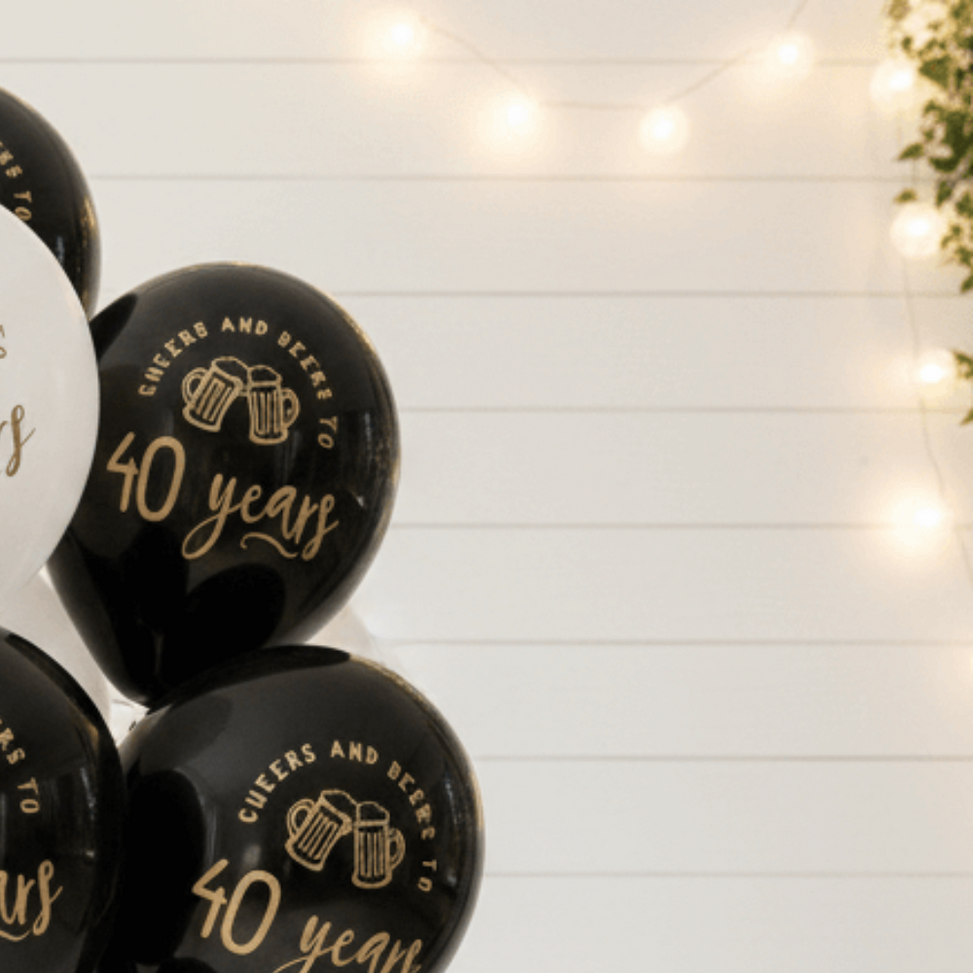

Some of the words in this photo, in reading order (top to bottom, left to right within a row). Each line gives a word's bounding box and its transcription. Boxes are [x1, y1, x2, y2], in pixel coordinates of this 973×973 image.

[13, 190, 33, 222] TO
[138, 321, 209, 397] CHEERS
[221, 316, 268, 336] AND
[277, 330, 333, 400] BEERS
[317, 415, 339, 449] TO
[106, 431, 186, 522] 40
[181, 472, 339, 561] years
[17, 777, 40, 814] TO
[238, 743, 317, 823] CHEERS
[330, 739, 379, 765] AND
[417, 858, 438, 892] TO
[191, 858, 281, 956] 40
